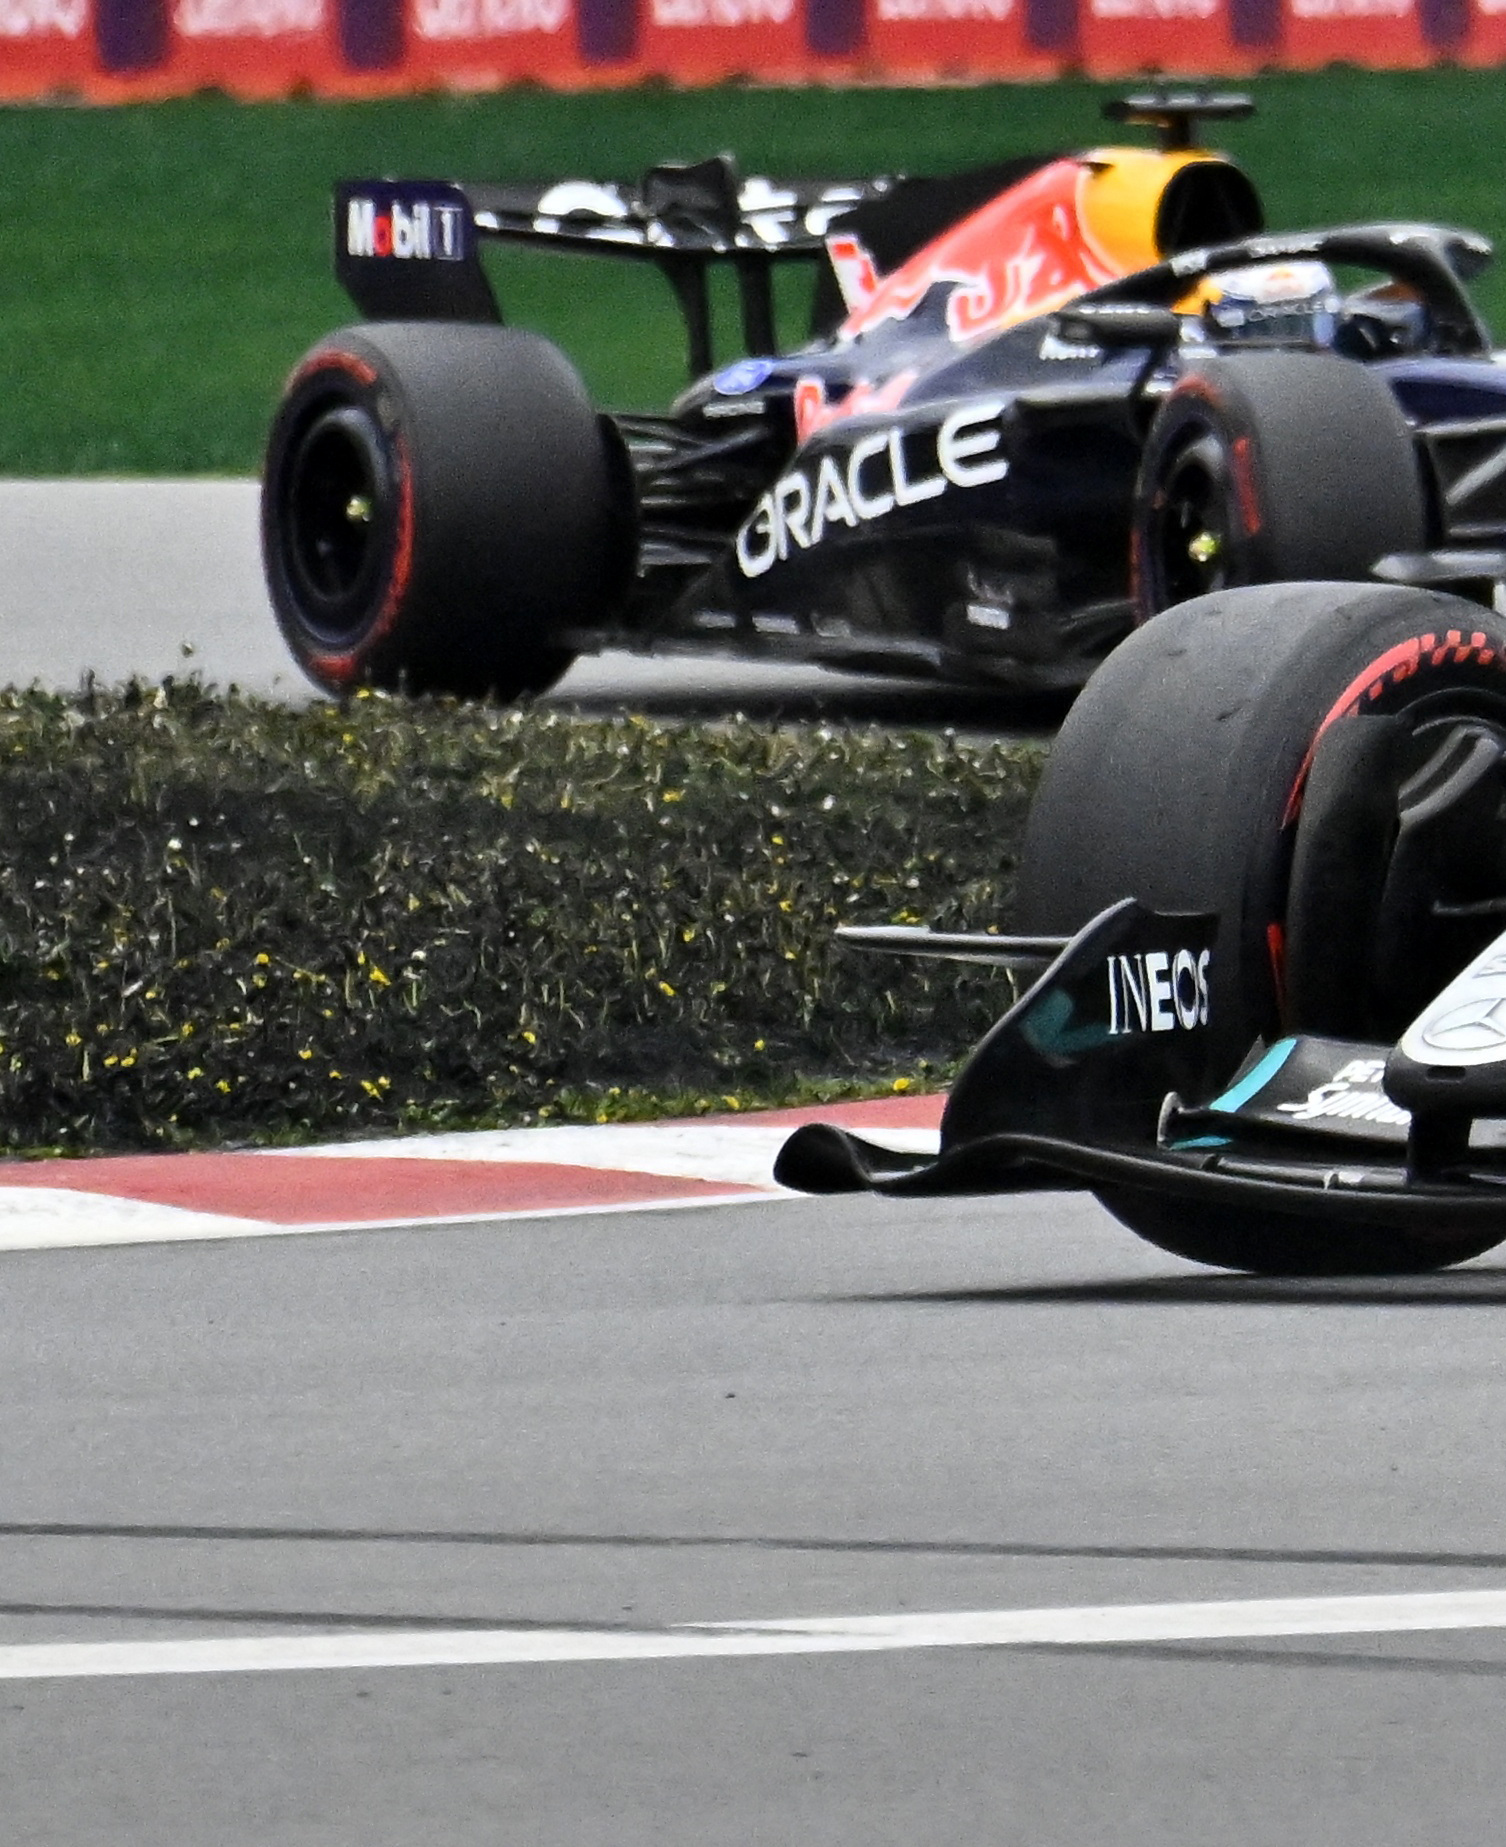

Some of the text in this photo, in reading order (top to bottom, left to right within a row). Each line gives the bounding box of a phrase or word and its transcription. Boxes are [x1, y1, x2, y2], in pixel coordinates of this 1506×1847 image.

[348, 199, 430, 259] Mobil
[735, 400, 1009, 579] ORACLE
[1106, 948, 1211, 1036] INEOS
